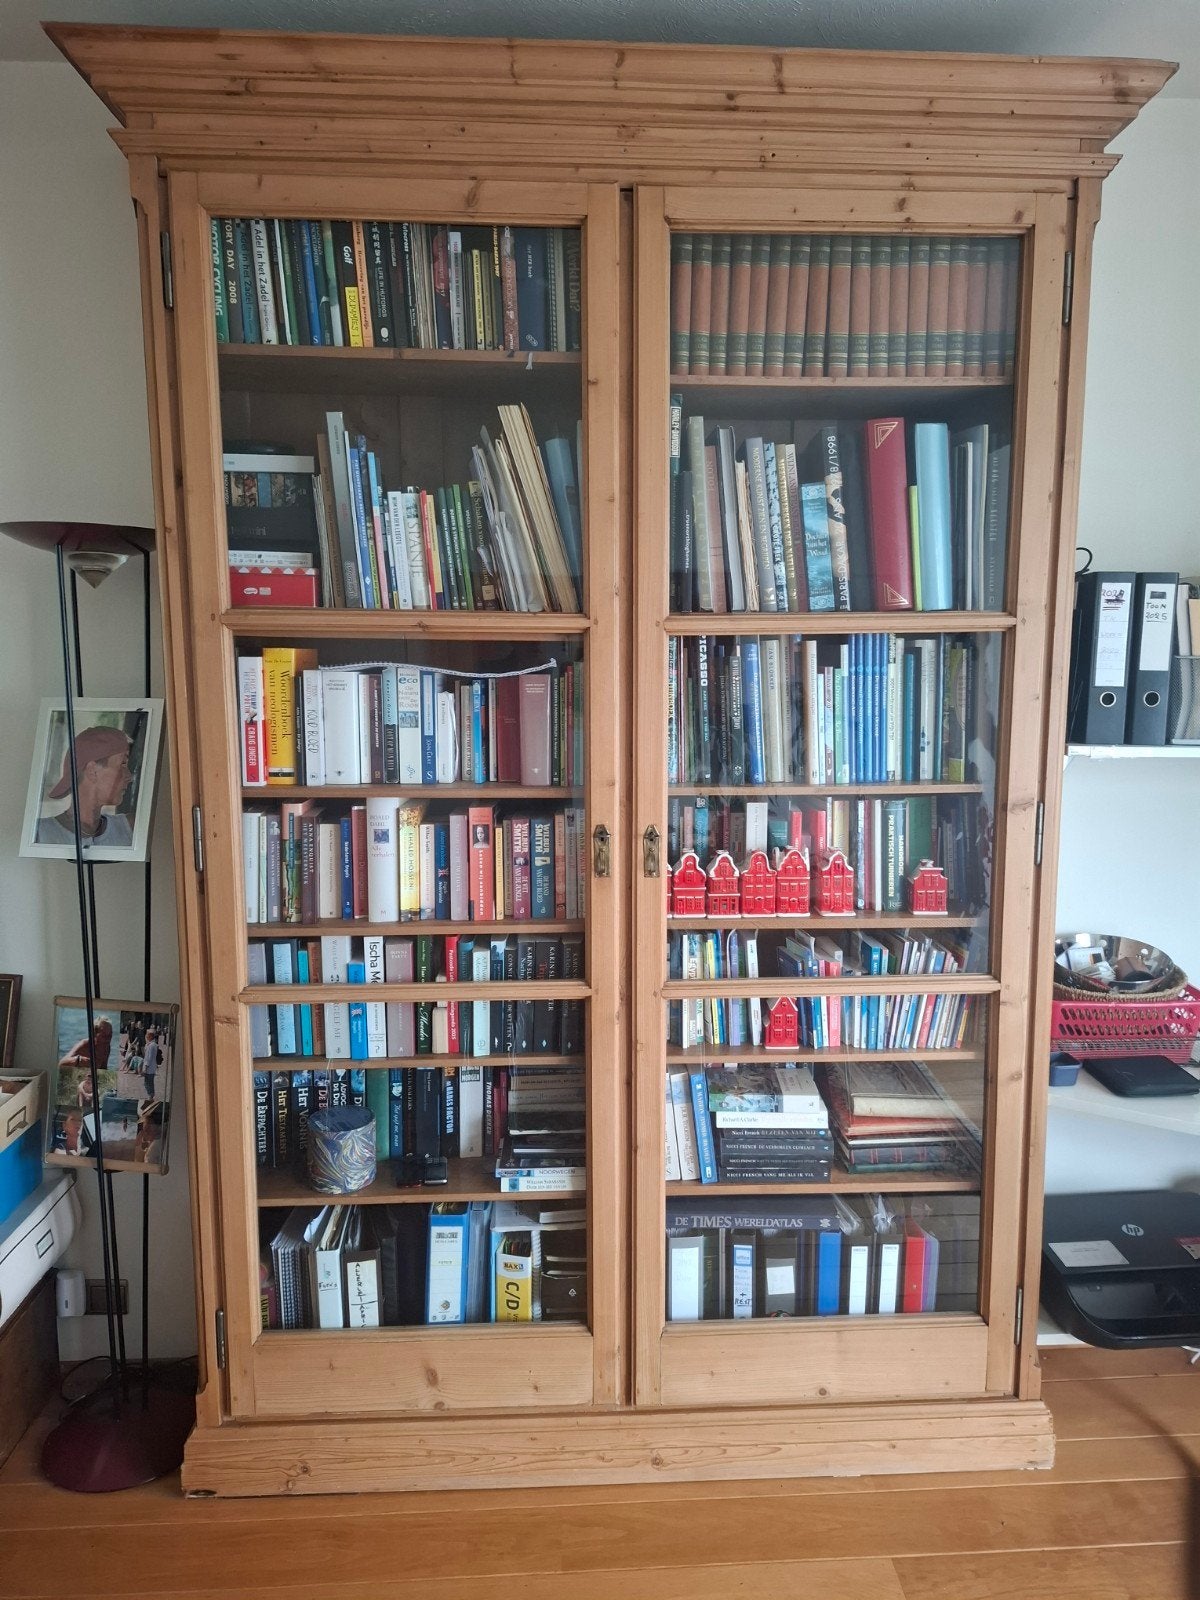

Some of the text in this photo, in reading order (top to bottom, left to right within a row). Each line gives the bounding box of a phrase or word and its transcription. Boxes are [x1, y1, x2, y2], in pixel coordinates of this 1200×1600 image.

[240, 232, 249, 251] Adel
[254, 228, 264, 248] Adel
[212, 220, 224, 316] MOTOR CYCLING
[225, 220, 236, 304] TORY DAY 2008
[258, 262, 267, 275] het
[343, 246, 353, 265] Golf
[243, 264, 251, 278] het
[245, 280, 254, 304] Zadel
[260, 278, 269, 302] Zadel
[569, 282, 580, 312] Dat?
[349, 295, 359, 331] DUMMIES
[672, 409, 680, 456] HARLEY-DAVIDSON
[752, 448, 762, 482] MODERNE
[827, 435, 839, 488] 1978/1998
[756, 484, 764, 506] KUNST
[472, 498, 483, 529] Schaken
[758, 507, 766, 523] ZIEN
[760, 525, 767, 533] EN
[407, 522, 422, 578] SPANJE
[836, 541, 848, 600] PARIS-DAKAR
[700, 635, 708, 687] PICASSO
[280, 670, 292, 739] Woordenboek
[248, 727, 256, 744] CRAIG
[268, 691, 279, 755] neologismen
[307, 730, 319, 754] BLOED
[535, 823, 543, 852] SMITH
[369, 942, 380, 968] Ischa
[318, 1089, 328, 1100] DE
[333, 1083, 340, 1091] DE
[446, 1086, 454, 1106] HADES
[257, 1091, 268, 1154] DE ERFPACHTERS
[278, 1091, 288, 1154] HET TESTAMENT
[298, 1088, 309, 1150] HET VONNIS
[675, 1216, 803, 1228] DE TIMES WERELDATLAS
[1122, 1224, 1144, 1236] hp
[505, 1282, 520, 1310] C/D
